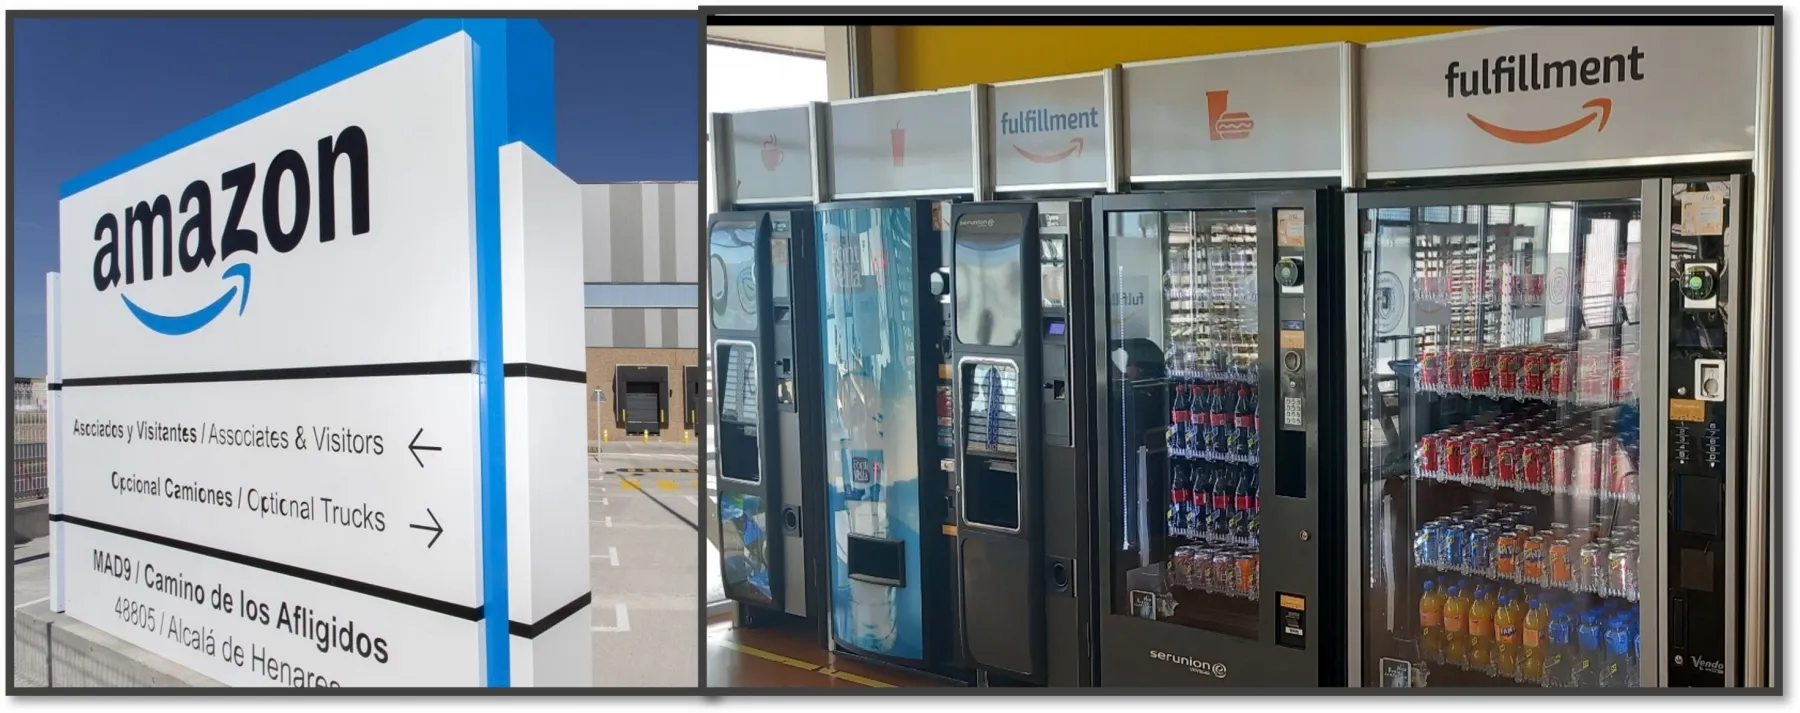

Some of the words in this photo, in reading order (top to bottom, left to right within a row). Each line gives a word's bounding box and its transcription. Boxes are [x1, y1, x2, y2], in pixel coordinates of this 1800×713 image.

[1444, 44, 1645, 98] fulfillment
[1000, 106, 1099, 136] fulfillment
[92, 124, 371, 292] amazon
[73, 418, 124, 440] Asociados
[126, 424, 134, 444] y
[136, 420, 197, 444] Visitantes
[200, 421, 206, 445] /
[208, 422, 290, 450] Associates
[295, 425, 308, 451] &
[313, 426, 385, 456] Visitors
[111, 470, 161, 497] Opcional
[164, 477, 233, 509] Camiones
[237, 486, 243, 510] /
[247, 488, 315, 522] Optional
[320, 496, 387, 532] Trucks
[93, 549, 132, 582] MAD9
[134, 560, 141, 584] /
[144, 562, 205, 605] Camino
[211, 583, 233, 614] de
[240, 590, 271, 626] los
[276, 601, 389, 665] Afligidos
[114, 596, 156, 633] 48805
[159, 611, 165, 636] /
[167, 615, 216, 657] Alcalá
[222, 635, 244, 667] de
[251, 643, 342, 688] Henare
[1149, 649, 1211, 670] serunion
[1690, 654, 1724, 669] Vendo
